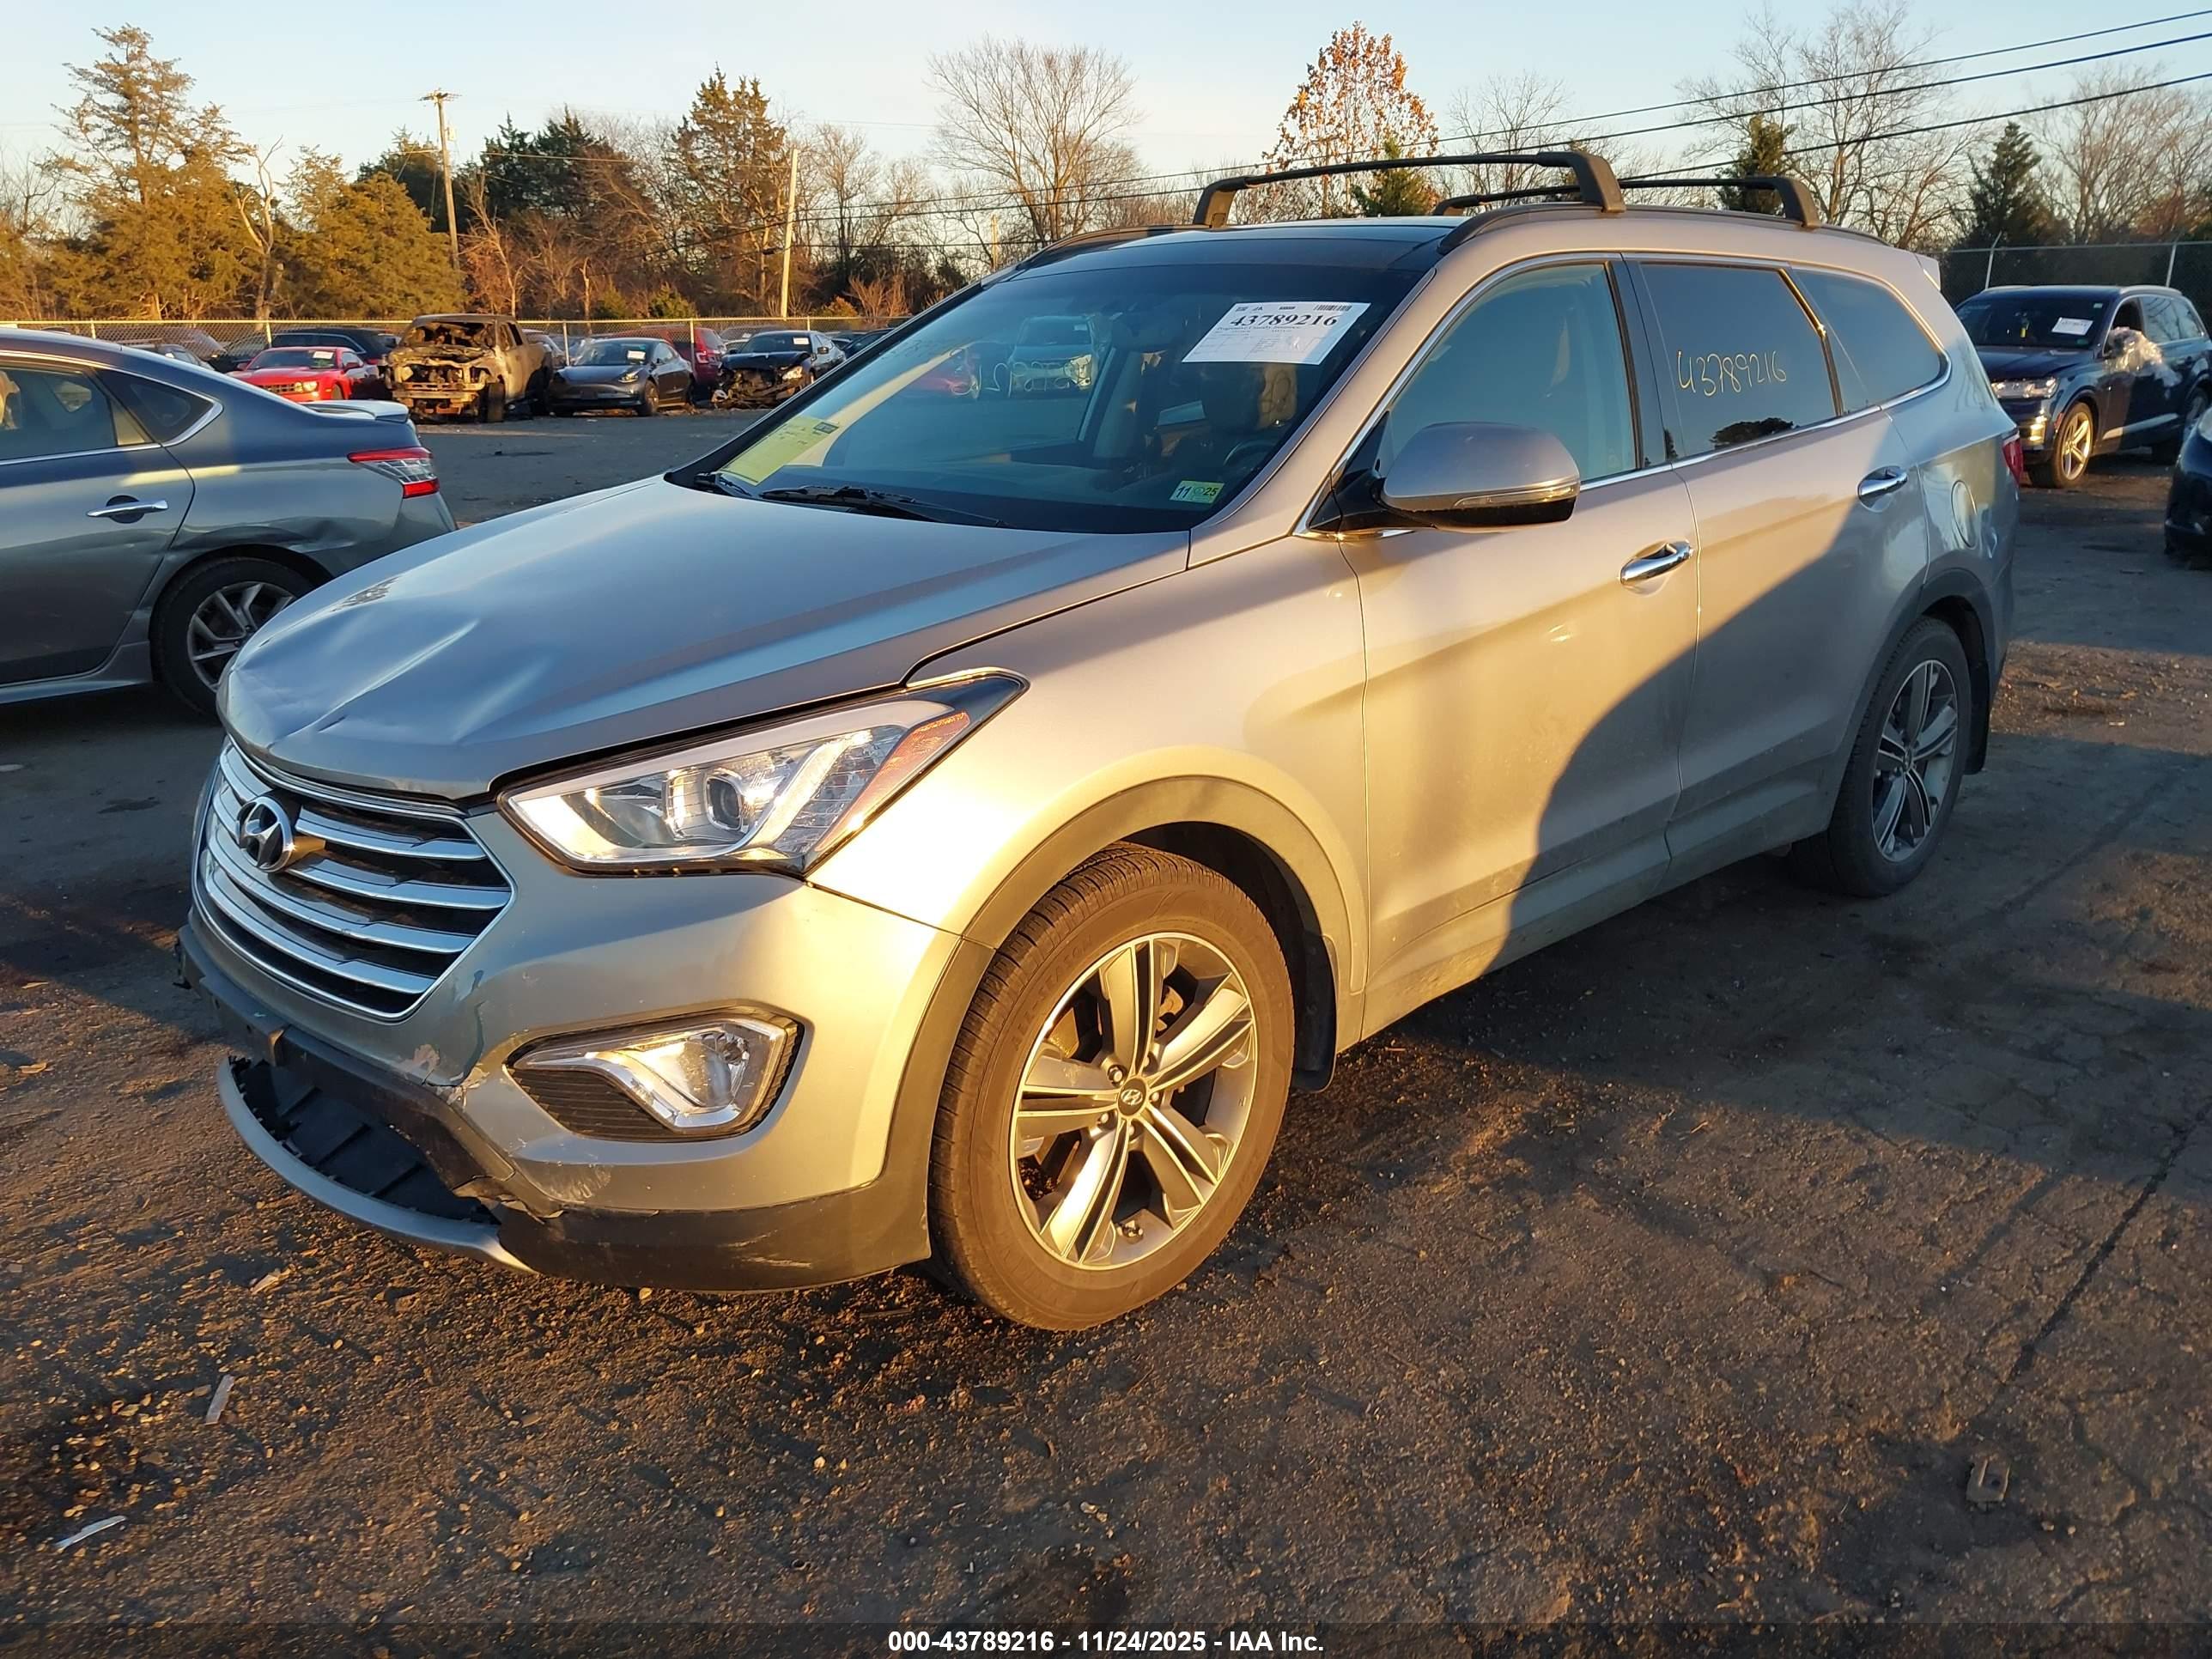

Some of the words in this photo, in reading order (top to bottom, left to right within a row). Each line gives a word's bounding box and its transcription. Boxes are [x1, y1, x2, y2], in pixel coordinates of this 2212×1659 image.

[1230, 314, 1341, 326] 43789216
[1677, 350, 1787, 397] 43789216
[1176, 486, 1192, 498] 11
[1204, 487, 1218, 496] 25
